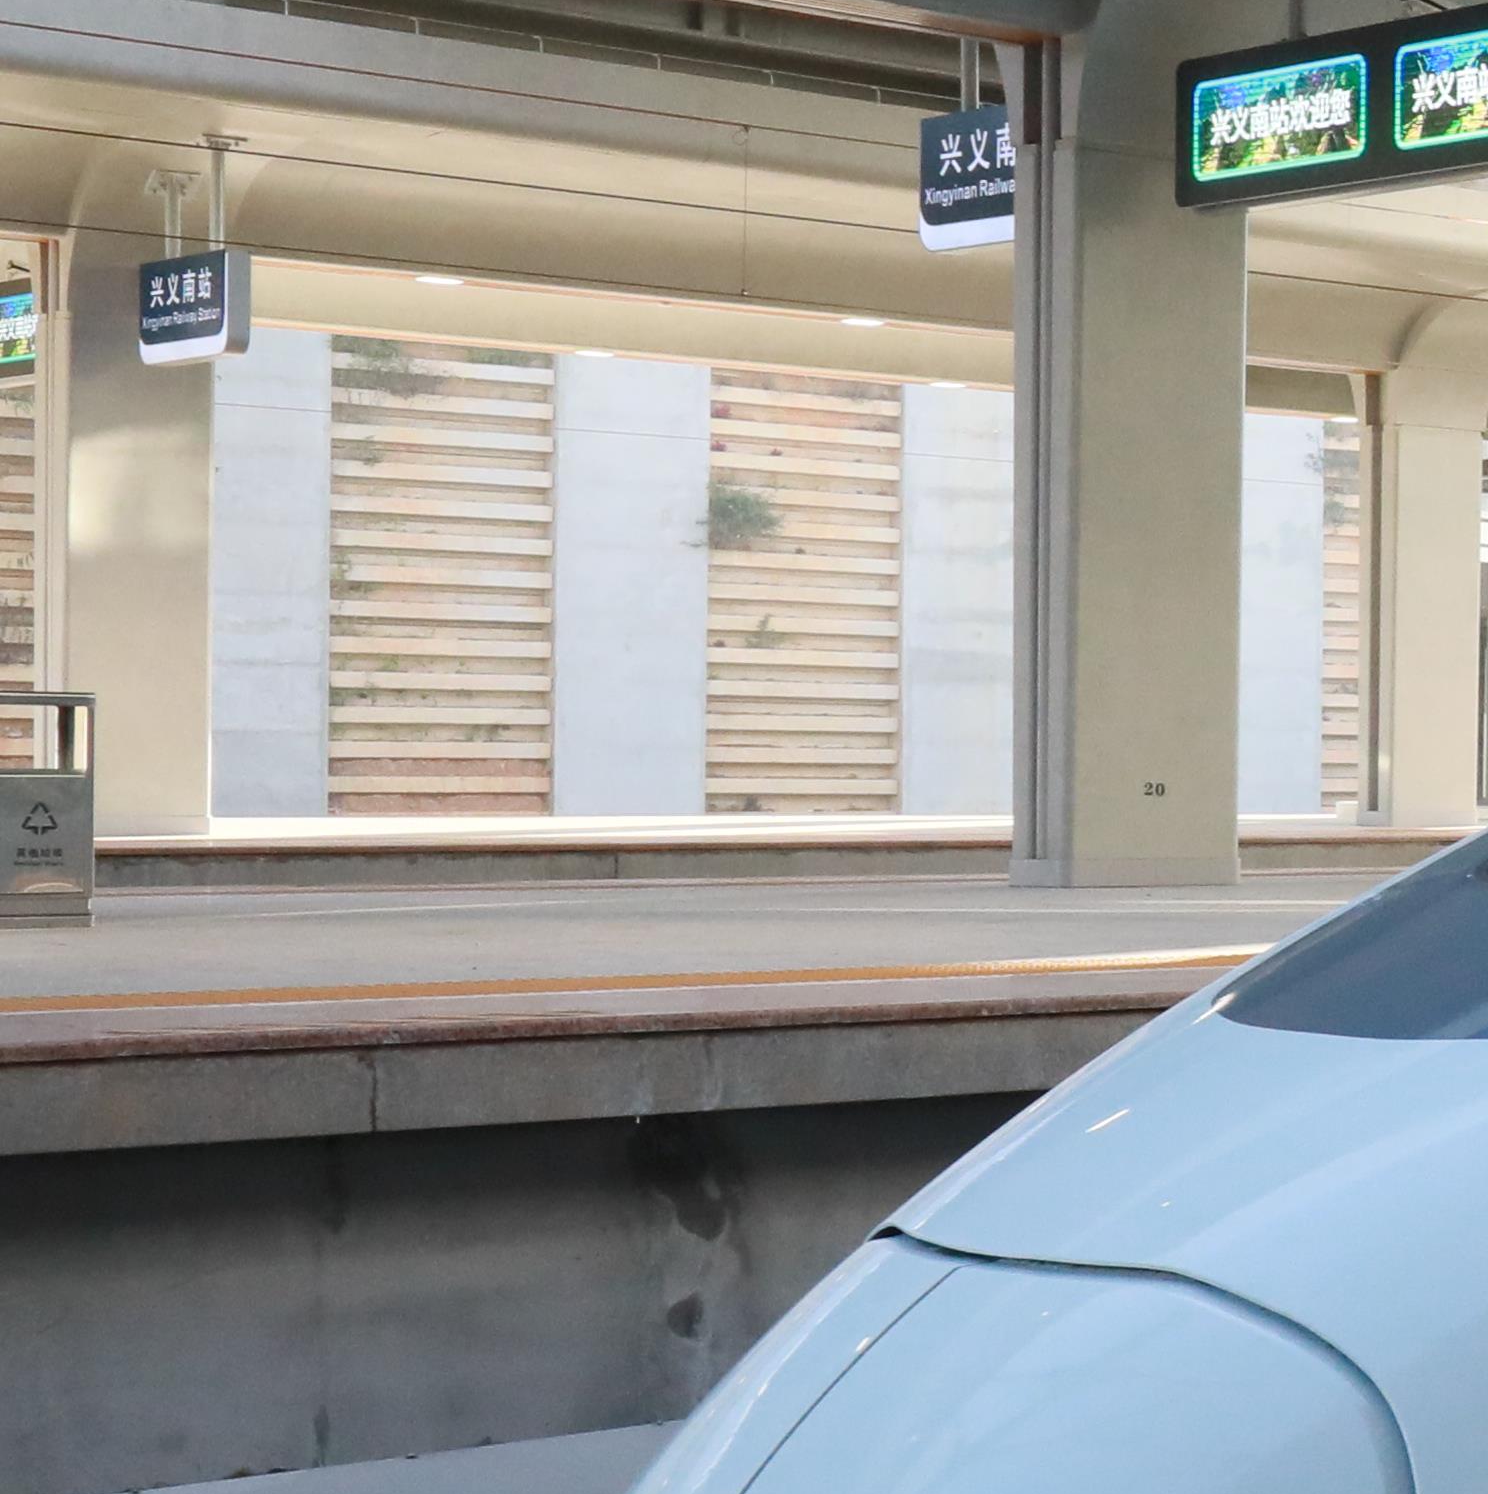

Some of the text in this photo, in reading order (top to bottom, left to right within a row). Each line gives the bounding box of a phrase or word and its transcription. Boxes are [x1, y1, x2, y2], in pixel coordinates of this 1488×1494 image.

[1210, 89, 1352, 146] 兴义南站欢迎您
[939, 123, 1016, 176] 兴义南
[925, 184, 978, 207] Xingyinan
[150, 266, 212, 308] 兴义南站
[1143, 782, 1166, 797] 20
